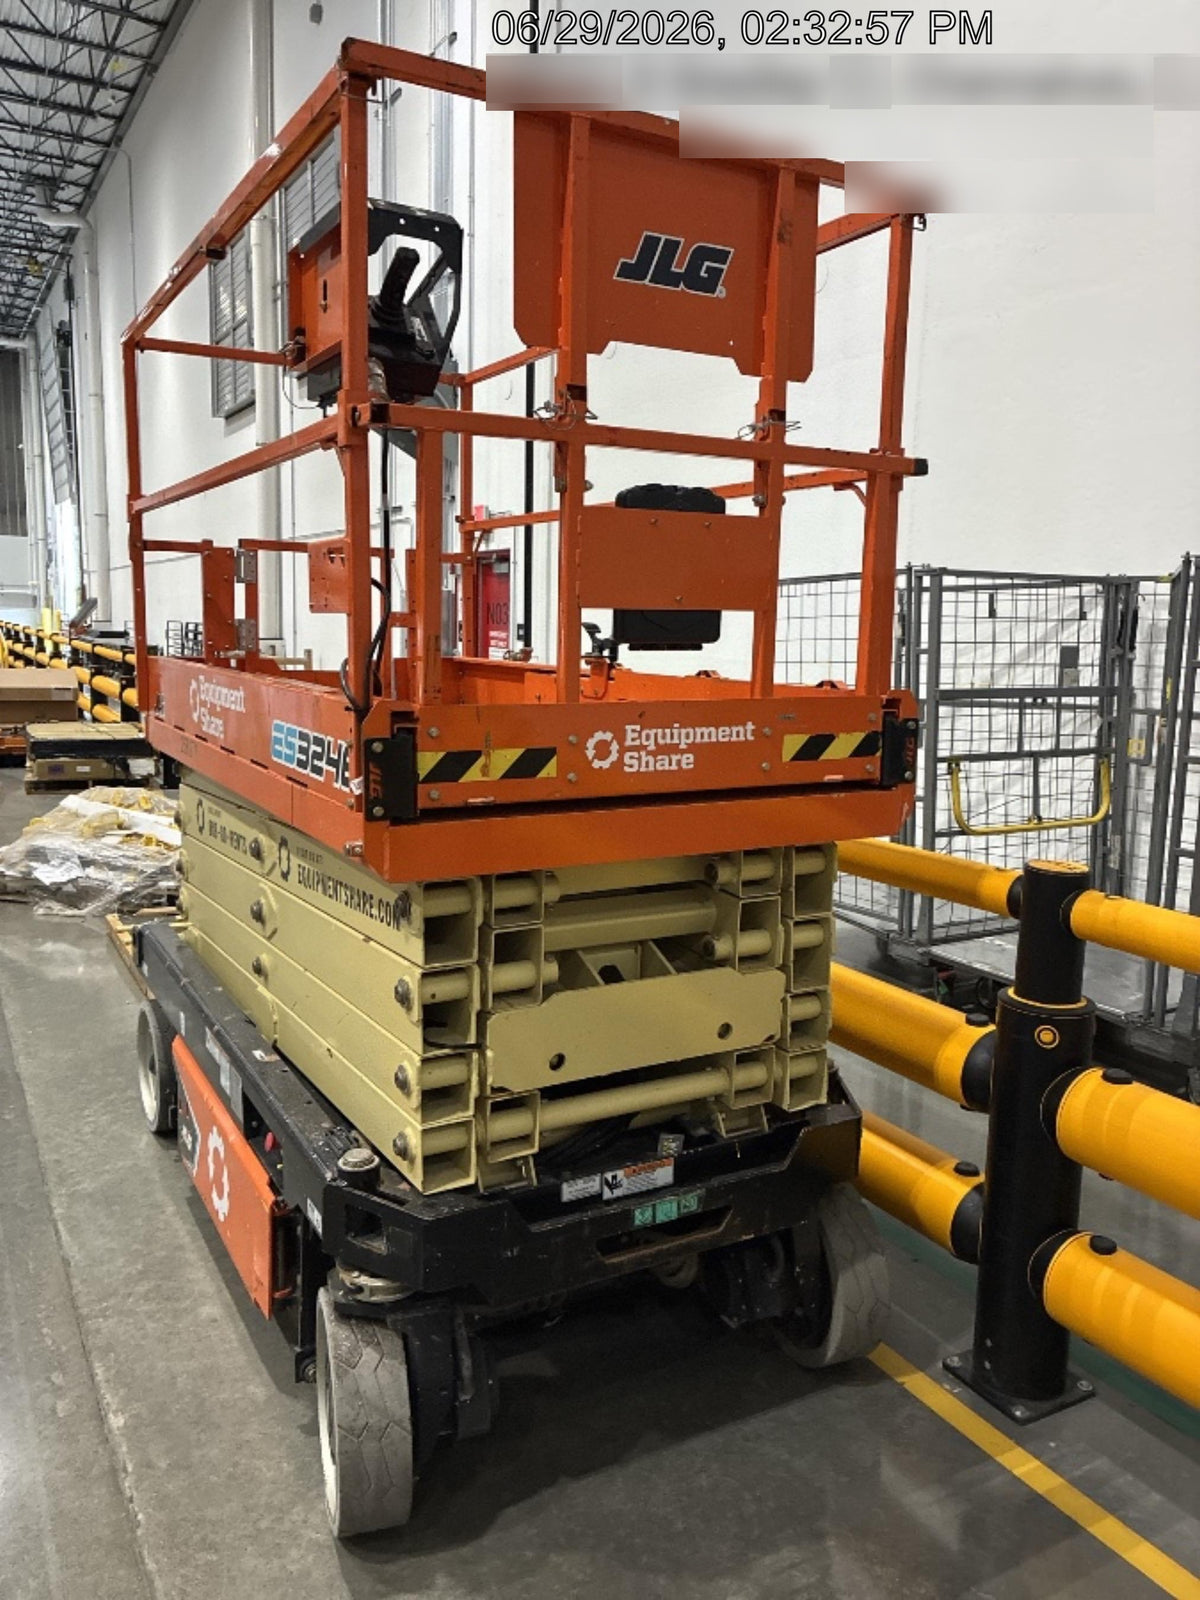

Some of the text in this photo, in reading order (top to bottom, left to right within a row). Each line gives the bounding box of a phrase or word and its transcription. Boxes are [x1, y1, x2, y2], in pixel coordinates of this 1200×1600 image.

[613, 230, 734, 298] JLG
[199, 675, 246, 714] Equipment
[200, 706, 225, 739] Share
[624, 721, 756, 750] Equipment
[623, 751, 695, 773] Share
